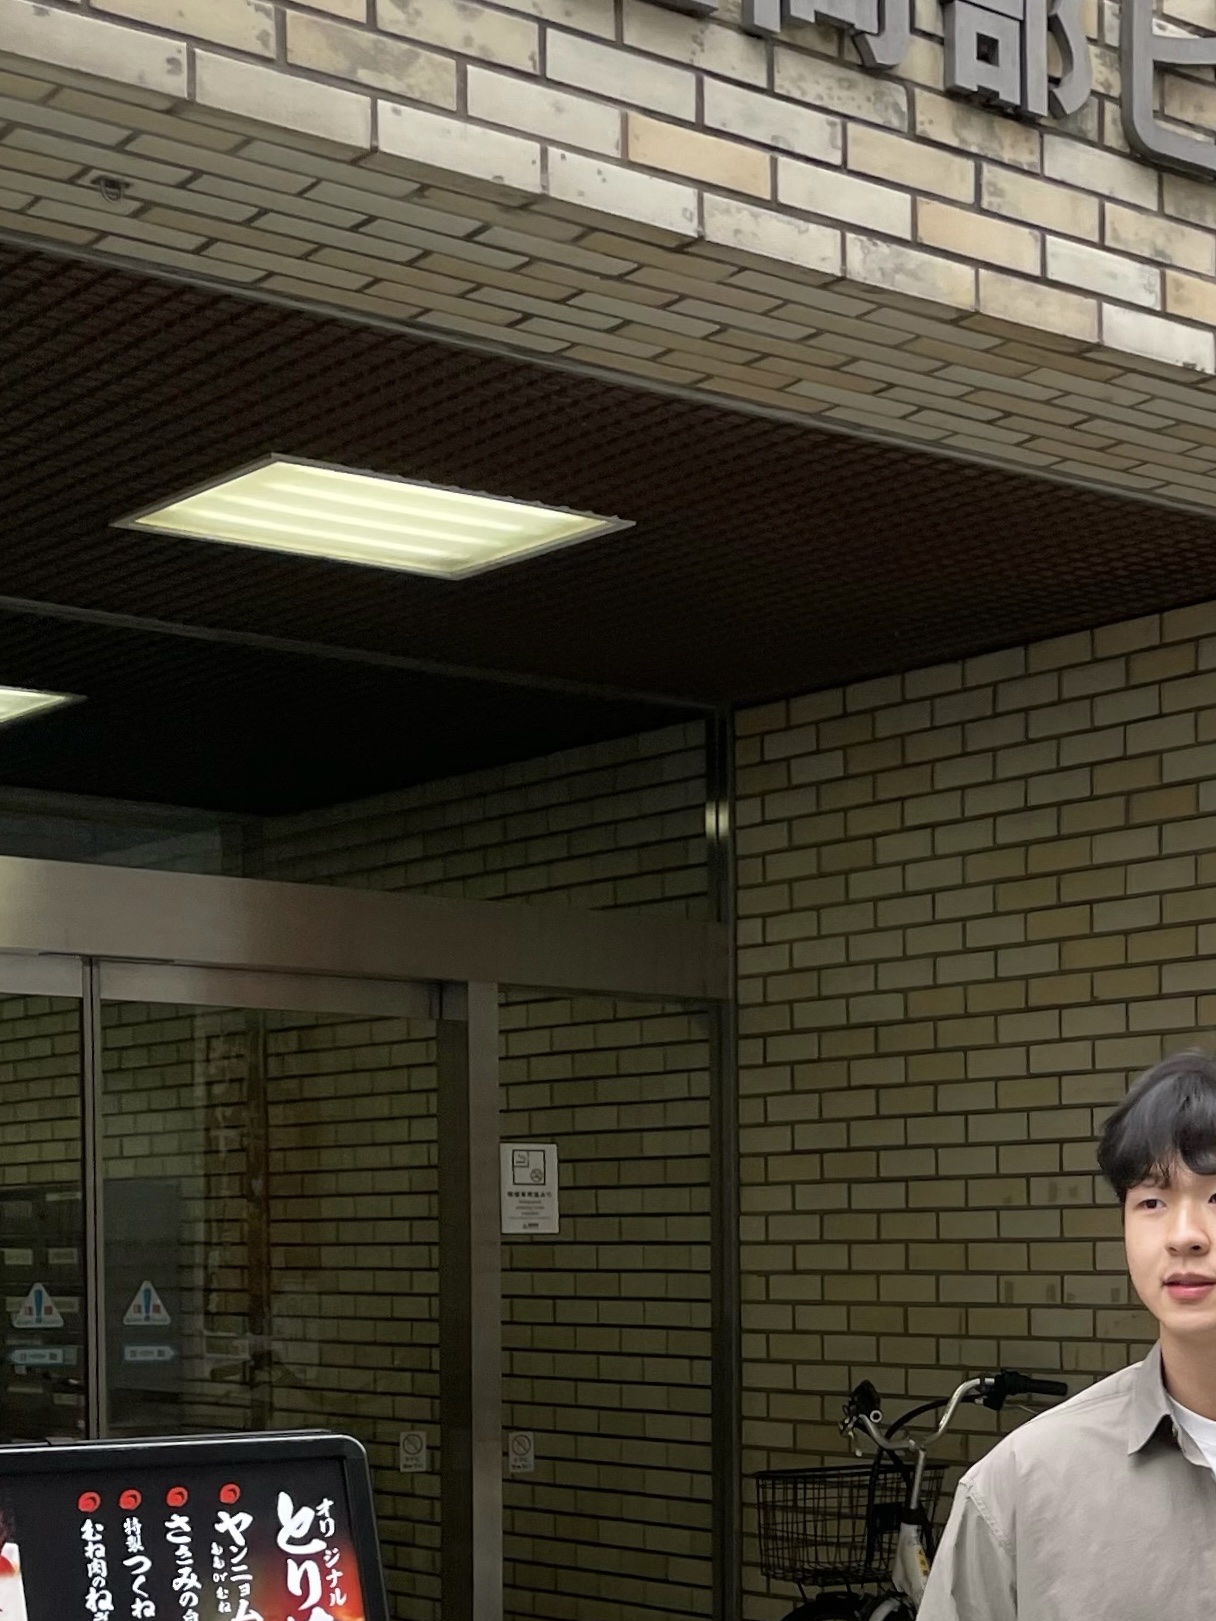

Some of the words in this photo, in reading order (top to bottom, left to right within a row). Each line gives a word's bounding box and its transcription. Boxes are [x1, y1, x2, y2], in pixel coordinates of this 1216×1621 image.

[122, 1516, 156, 1619] 特製つくね
[316, 1498, 347, 1607] オリジナル
